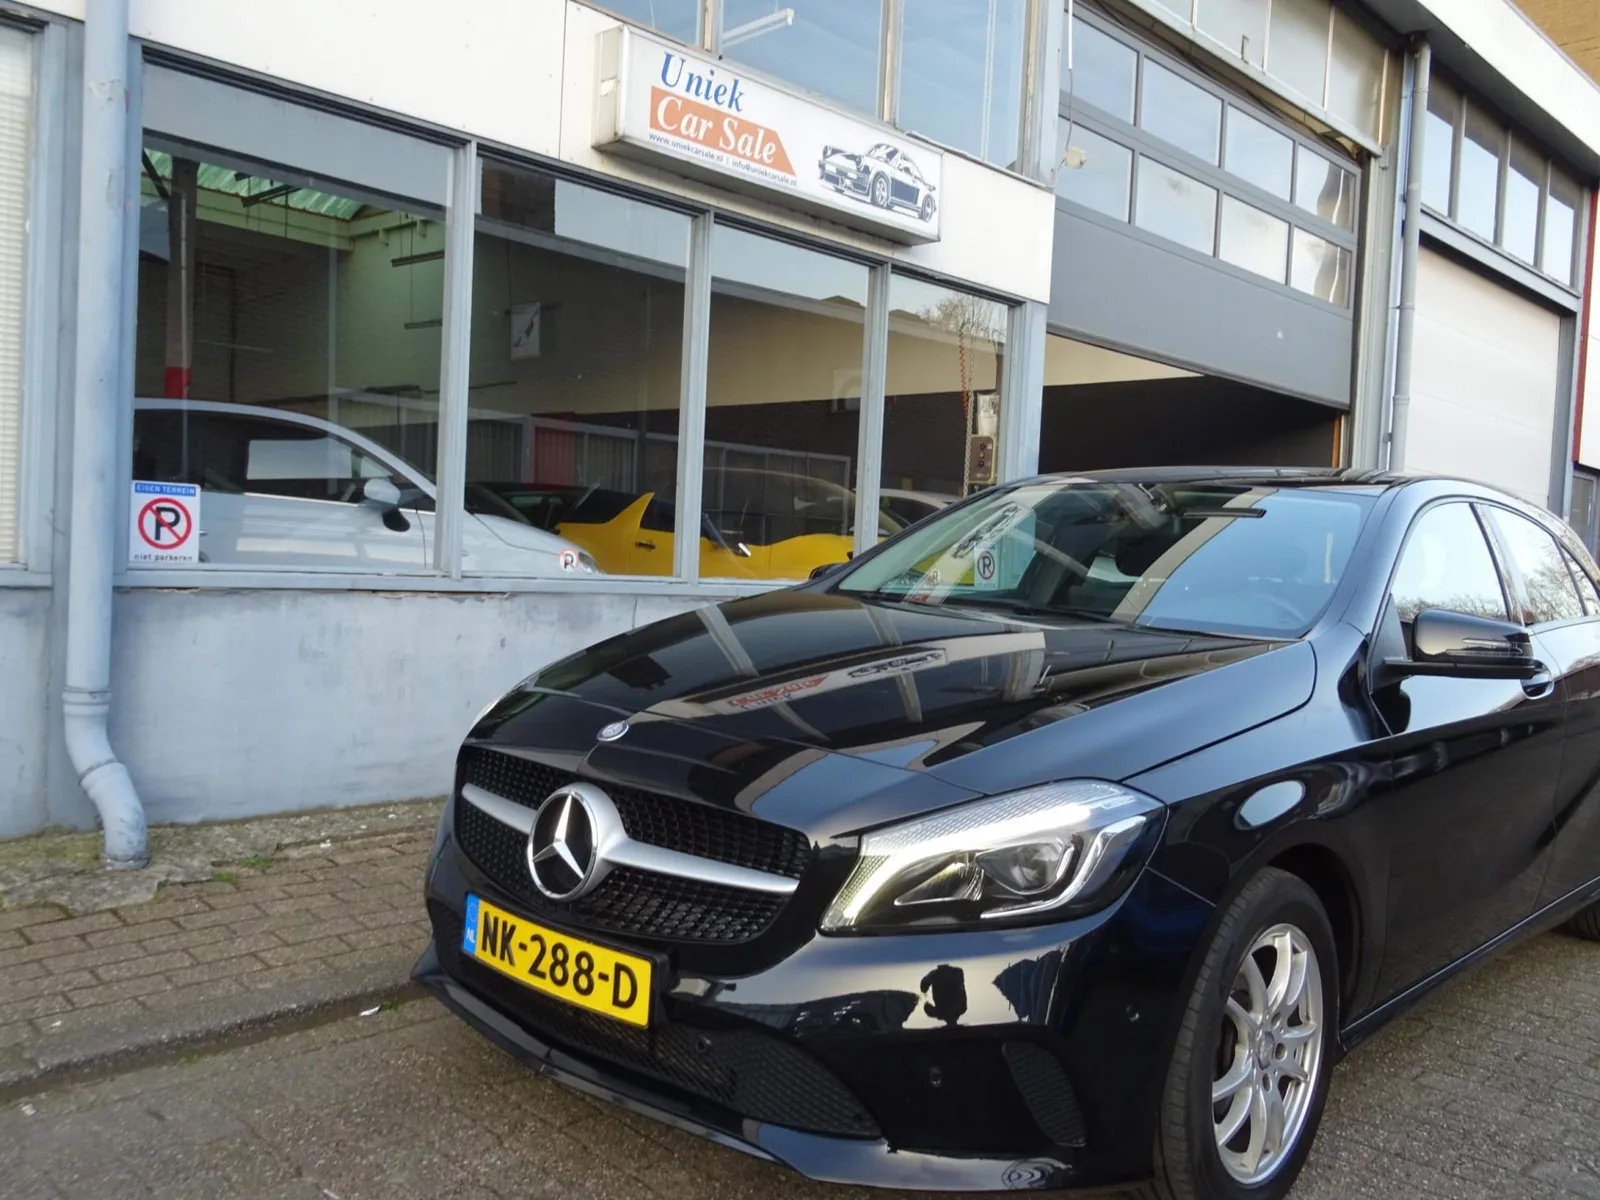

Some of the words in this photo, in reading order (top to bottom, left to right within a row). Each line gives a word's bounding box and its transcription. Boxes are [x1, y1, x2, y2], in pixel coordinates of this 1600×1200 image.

[661, 52, 745, 112] Uniek
[657, 96, 713, 141] Car
[719, 117, 776, 164] Sale
[649, 132, 724, 162] www.uniekcarsale.nl
[731, 159, 798, 187] info@uniekcarsale.nl
[136, 484, 160, 492] EIGEN
[163, 486, 195, 495] TERREIN
[466, 927, 476, 944] NL
[481, 911, 638, 1009] NK-288-D
